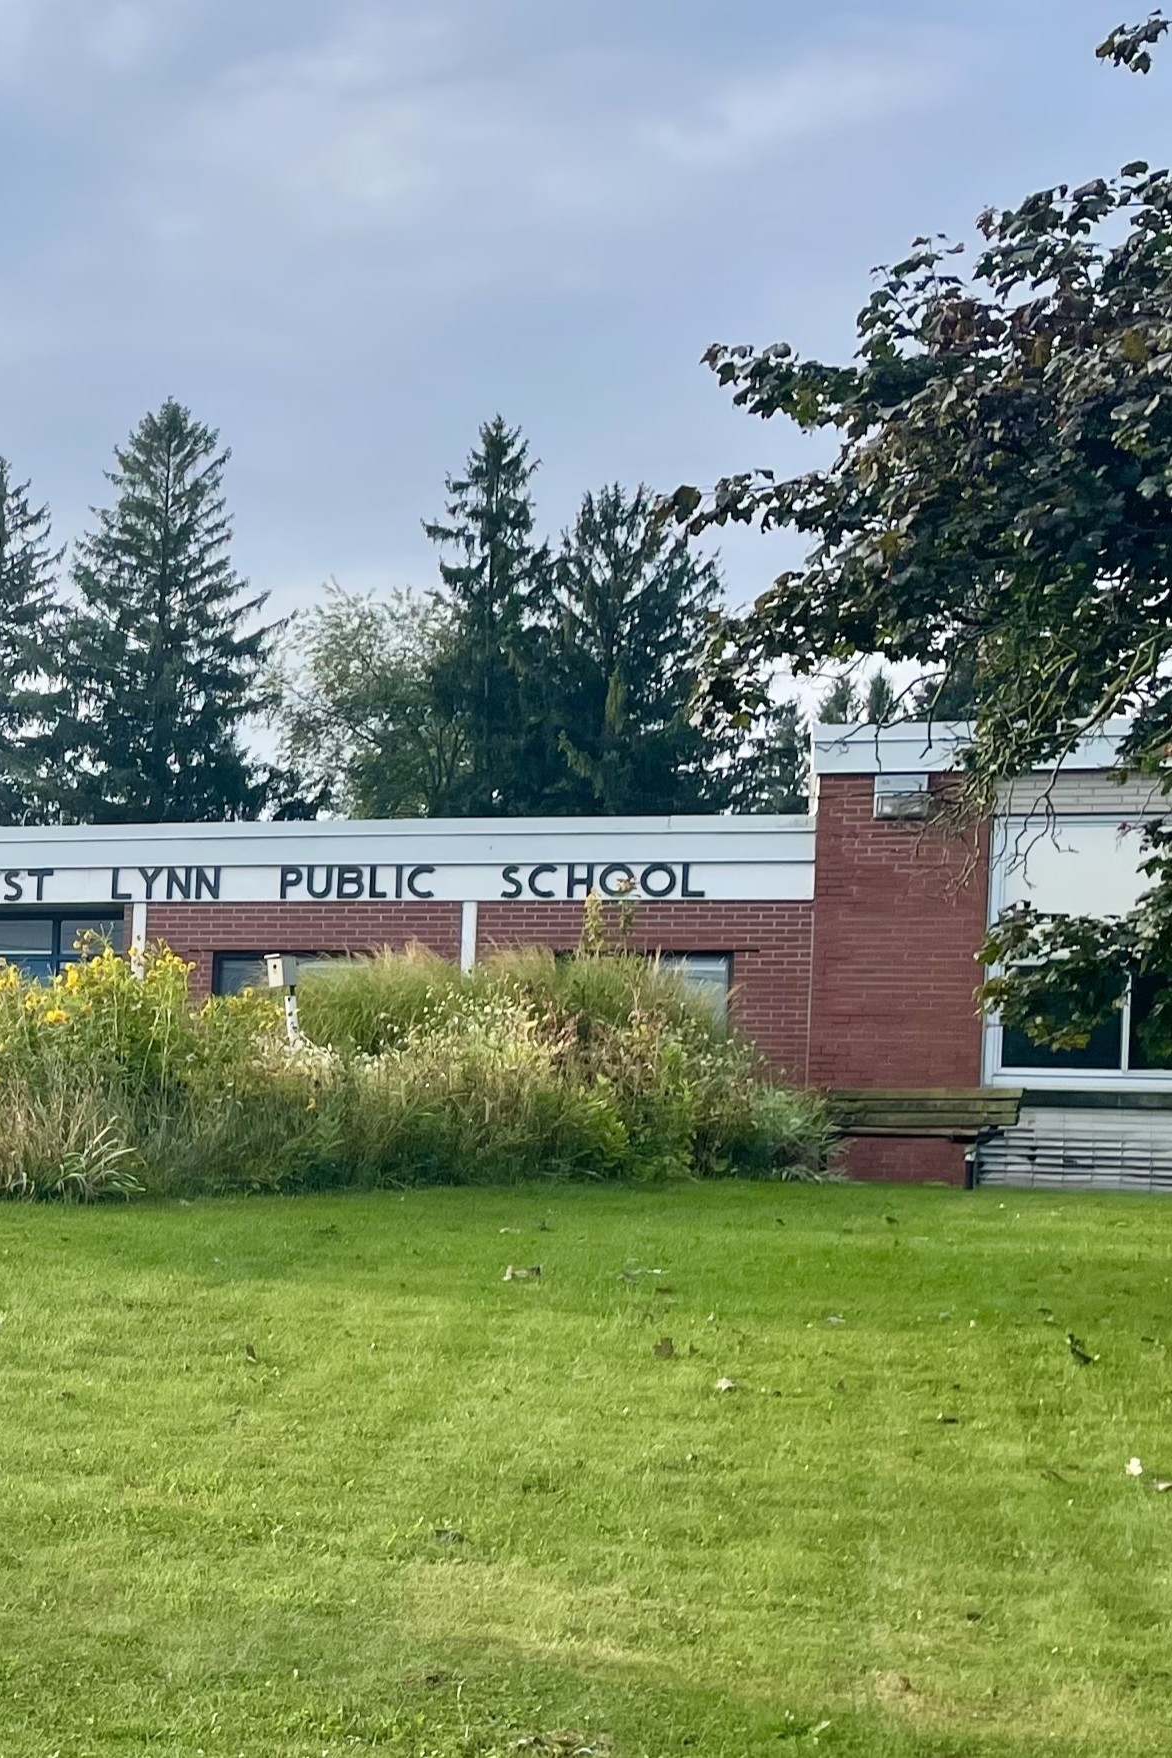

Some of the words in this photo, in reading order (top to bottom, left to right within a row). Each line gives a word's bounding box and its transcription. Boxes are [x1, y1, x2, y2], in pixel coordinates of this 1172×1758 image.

[111, 866, 221, 900] LYNN
[280, 865, 435, 899] PUBLIC
[500, 863, 705, 898] SCHOOL
